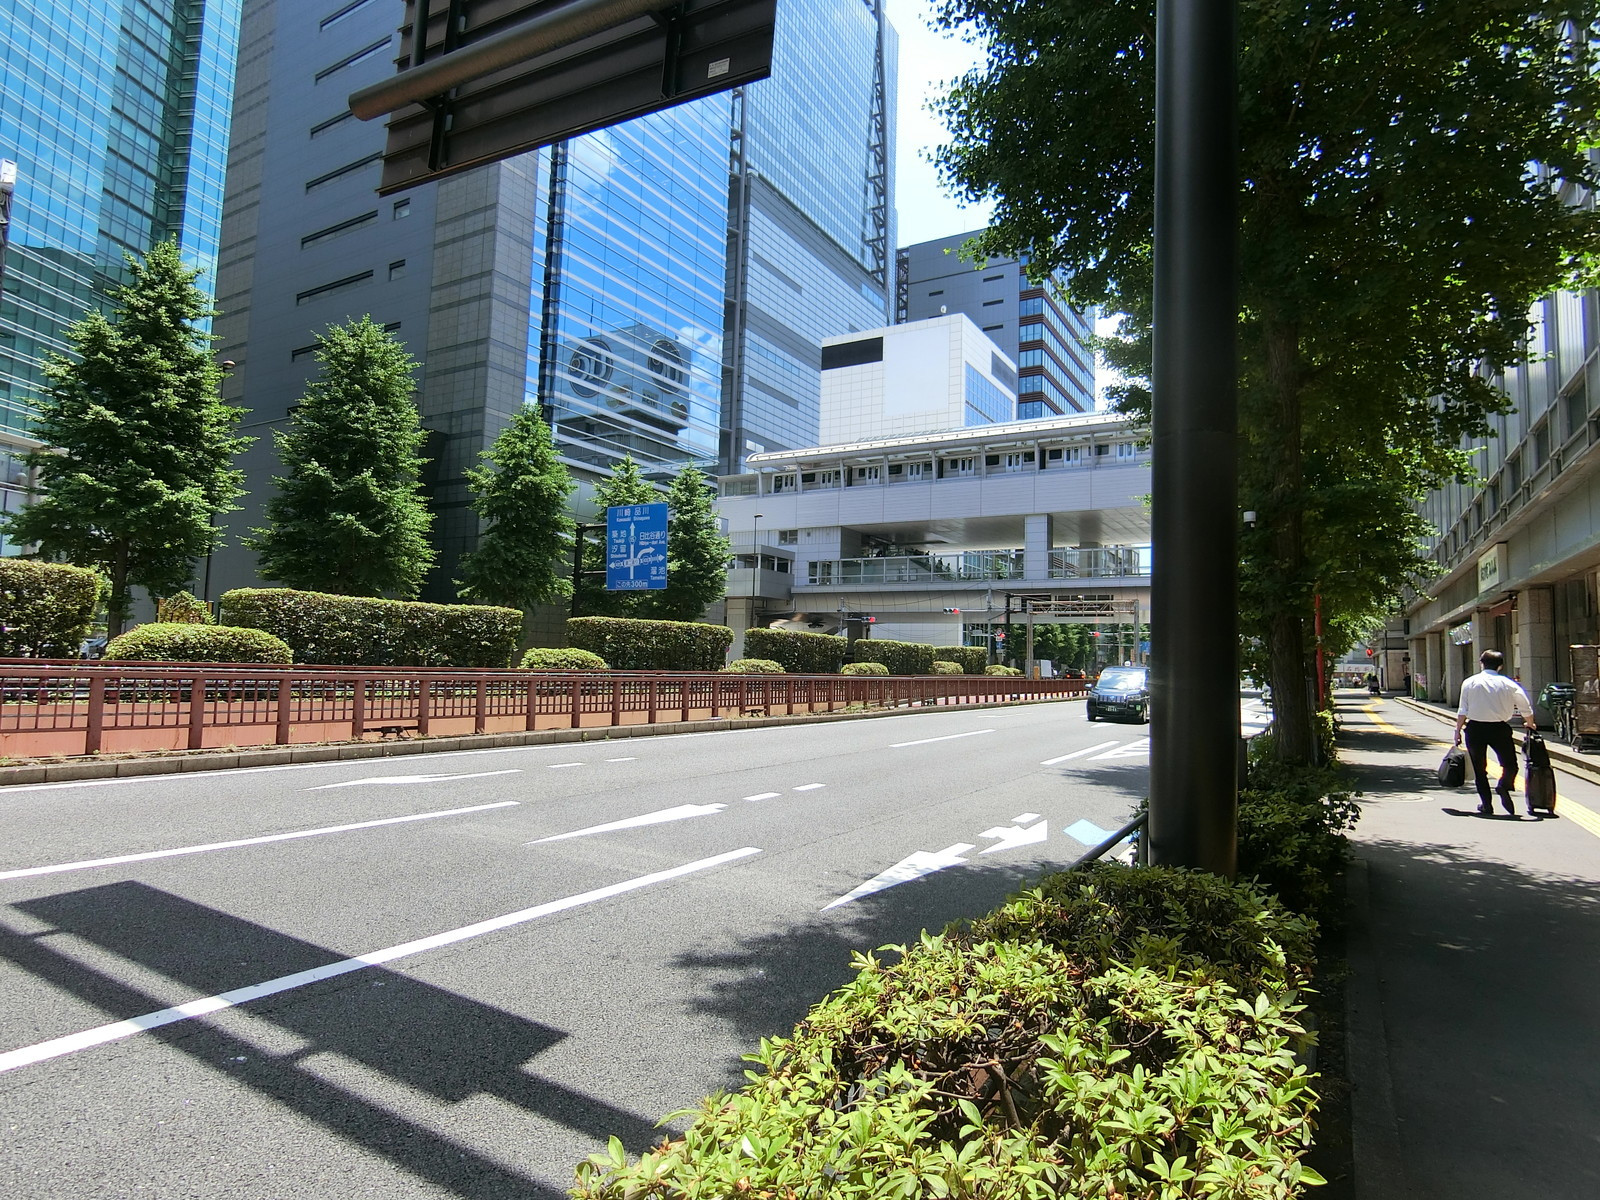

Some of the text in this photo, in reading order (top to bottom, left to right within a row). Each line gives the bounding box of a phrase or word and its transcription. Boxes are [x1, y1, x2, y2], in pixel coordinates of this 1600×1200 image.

[634, 507, 650, 516] 品川
[640, 531, 666, 540] 日比谷通り
